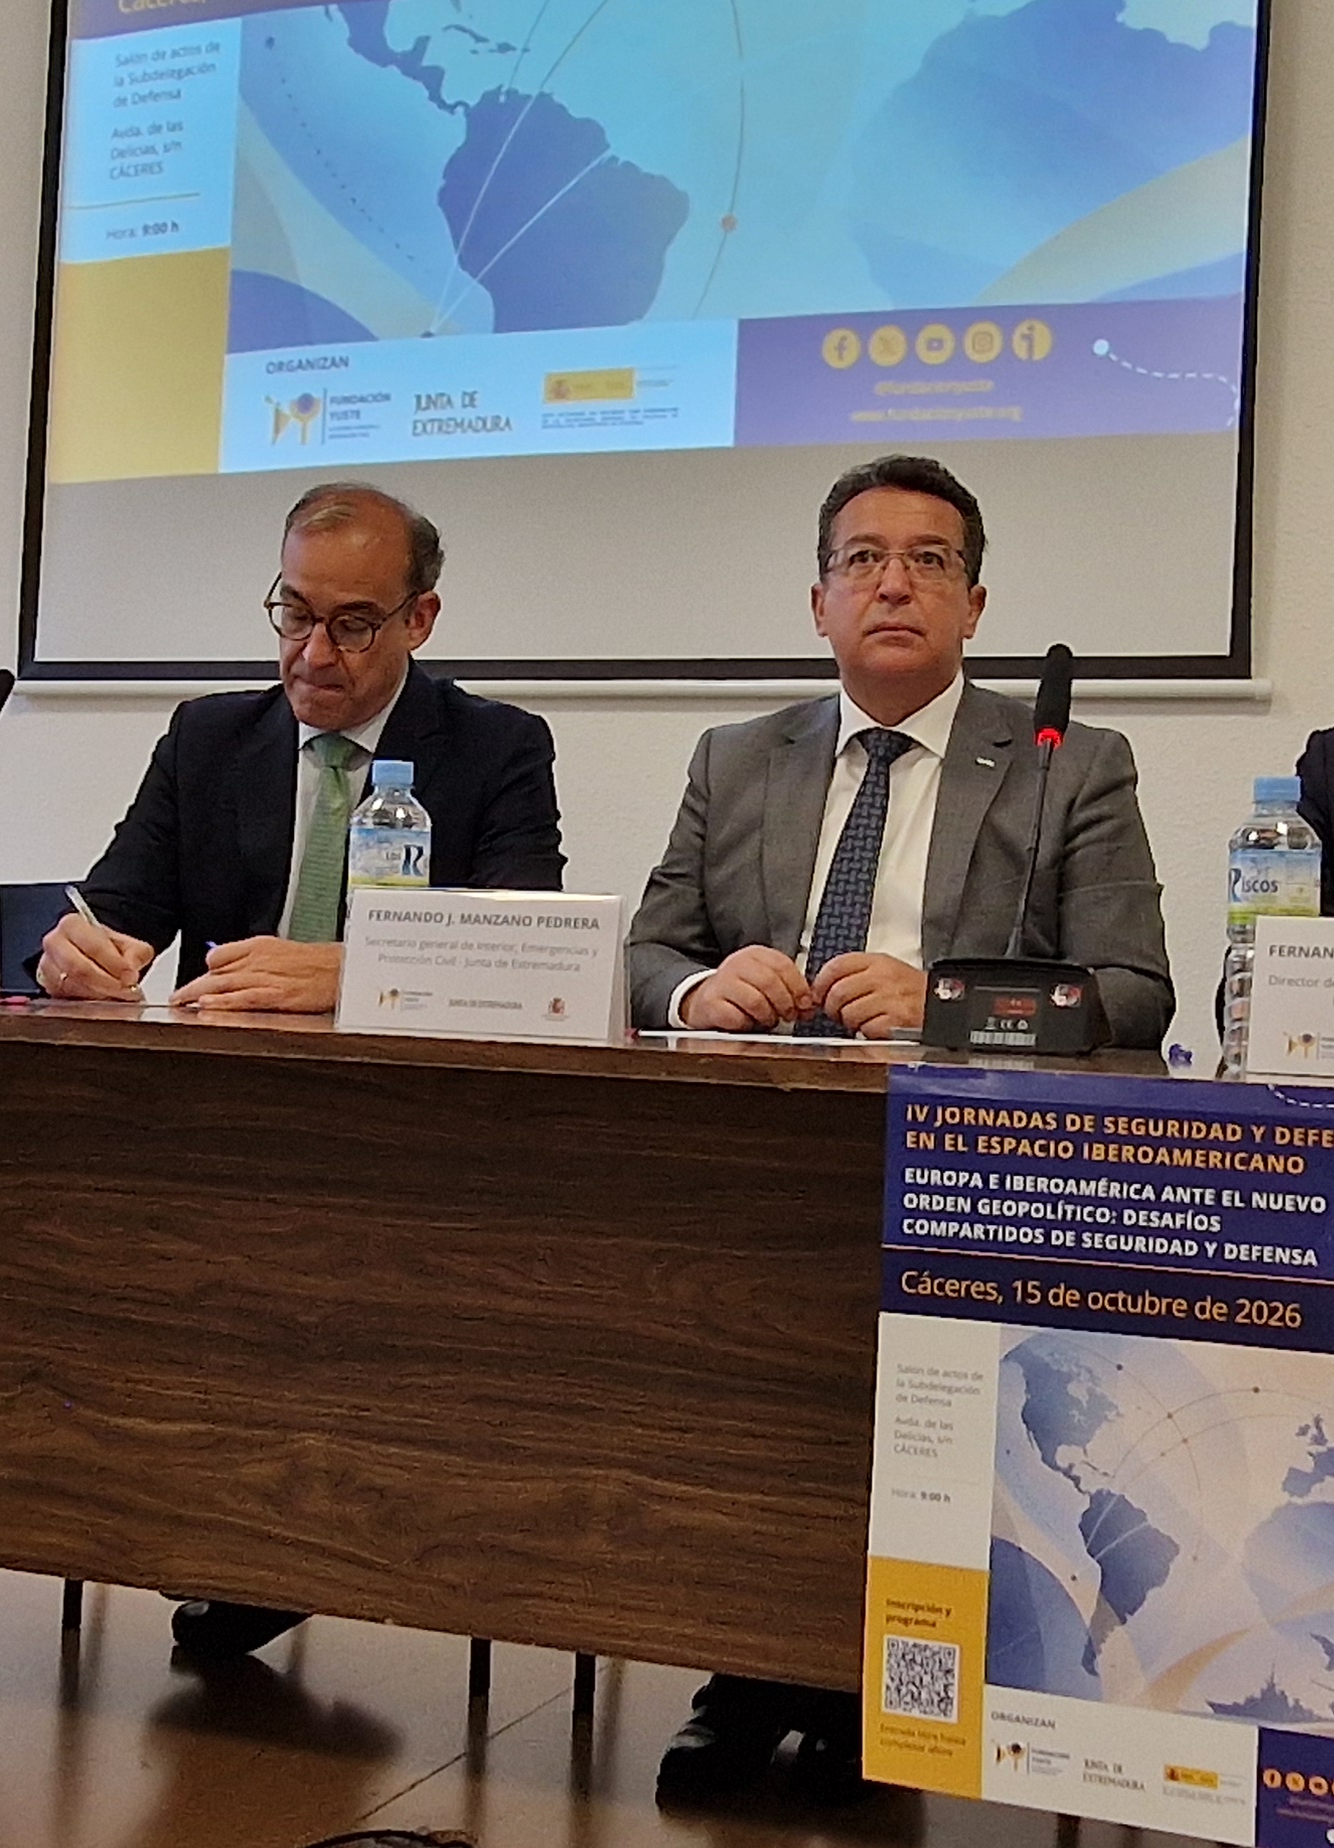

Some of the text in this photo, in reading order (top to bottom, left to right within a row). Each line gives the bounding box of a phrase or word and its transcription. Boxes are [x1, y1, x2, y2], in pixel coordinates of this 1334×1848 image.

[266, 355, 350, 374] ORGANIZAN
[414, 391, 478, 414] JUNTA DE
[412, 415, 513, 437] EXTREMADURA
[368, 910, 444, 923] FERNANDO
[460, 913, 532, 927] MANZANO
[537, 916, 600, 930] PEDRERA
[1268, 974, 1319, 988] Director
[906, 1103, 929, 1123] IV
[934, 1105, 1058, 1131] JORNADAS
[1065, 1113, 1096, 1133] DE
[1103, 1116, 1243, 1143] SEGURIDAD
[1251, 1124, 1267, 1144] Y
[905, 1131, 1306, 1175] EN EL ESPACIO IBEROAMERICANO
[904, 1167, 1327, 1214] EUROPA E IBEROAMÉRICA ANTE EL NUEVO
[903, 1192, 1222, 1233] ORDEN GEOPOLÍTICO: DESAFÍOS
[902, 1218, 1319, 1268] COMPARTIDOS DE SEGURIDAD Y DEFENSA
[900, 1269, 1303, 1330] Cáceres, 15 de octubre de 2026
[990, 1710, 1056, 1730] ORGANIZAN
